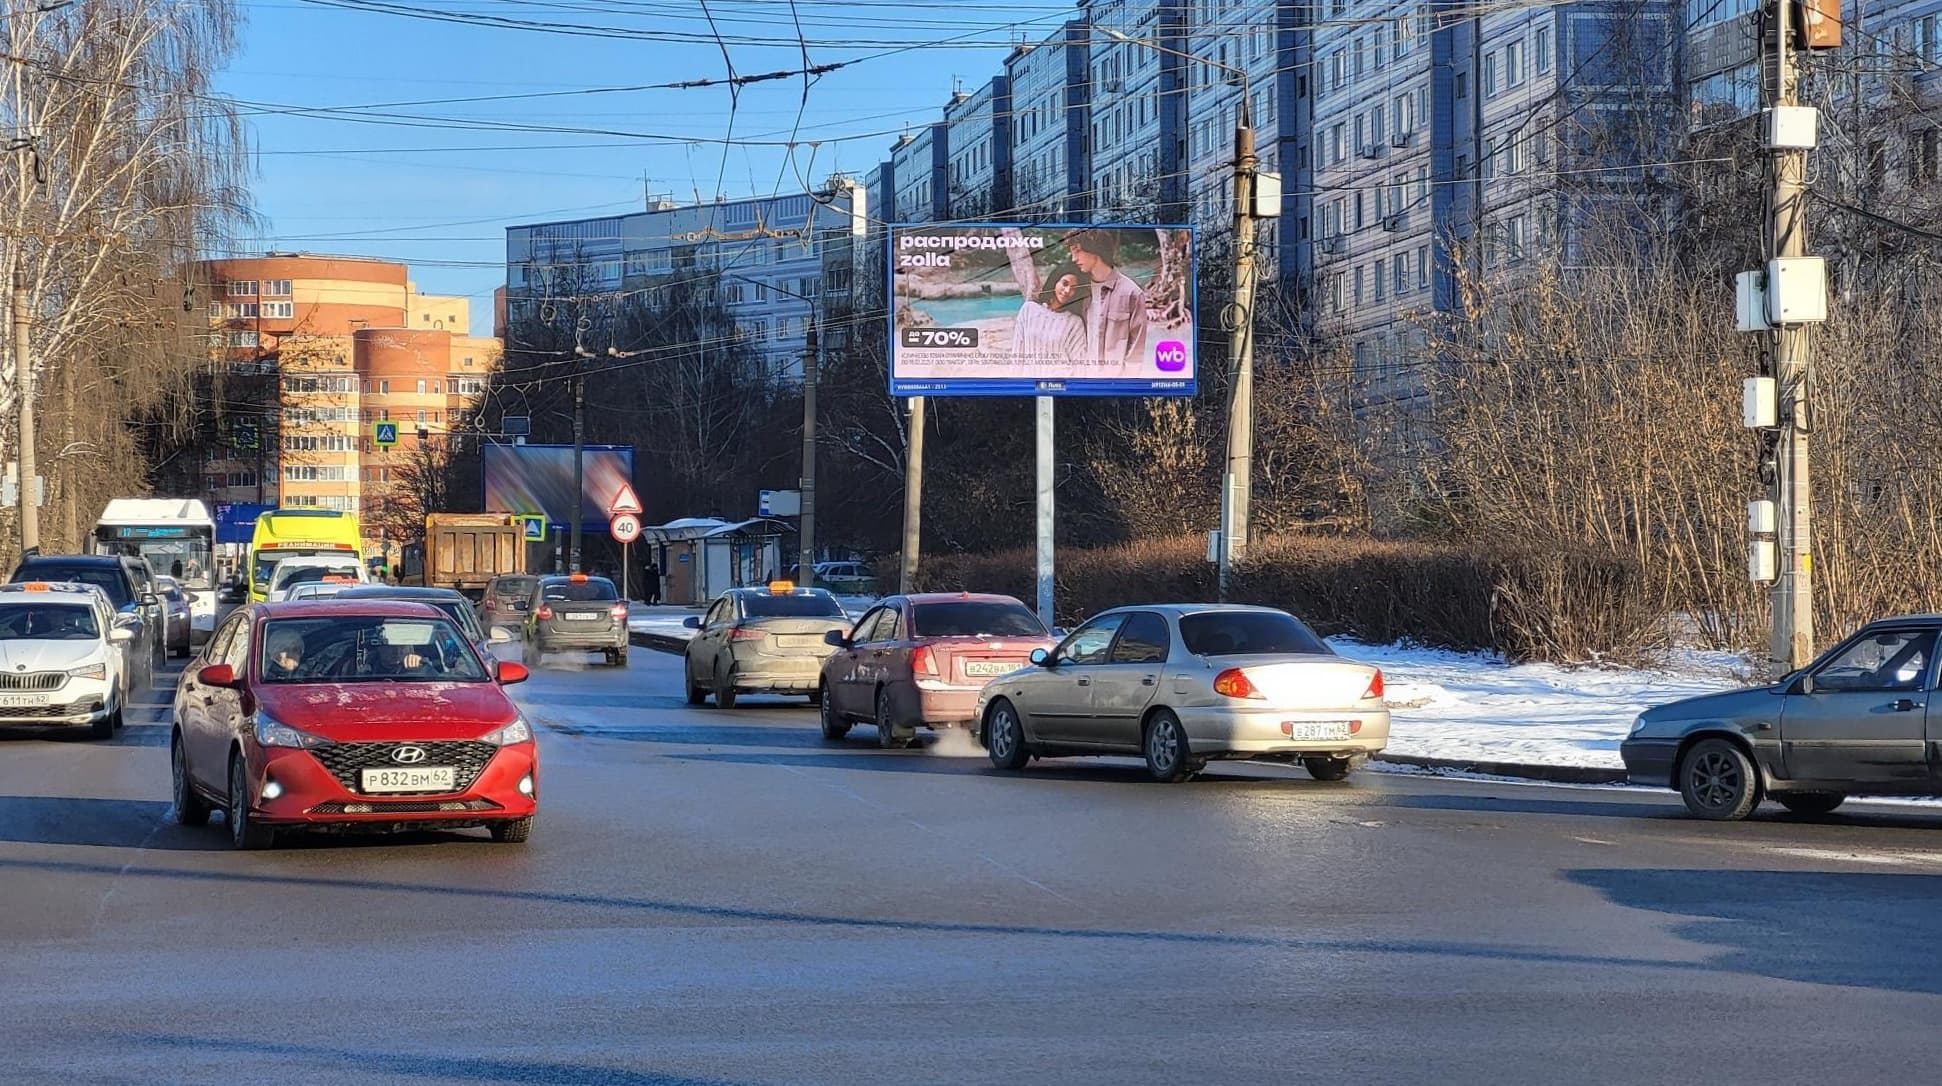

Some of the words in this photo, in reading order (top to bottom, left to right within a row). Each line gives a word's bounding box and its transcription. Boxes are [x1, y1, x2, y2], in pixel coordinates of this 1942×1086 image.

[900, 235, 1044, 250] распродажа
[900, 252, 951, 267] zolla
[1157, 347, 1185, 363] wb
[617, 522, 634, 533] 40
[0, 696, 34, 705] 611ТН
[433, 770, 448, 781] 62
